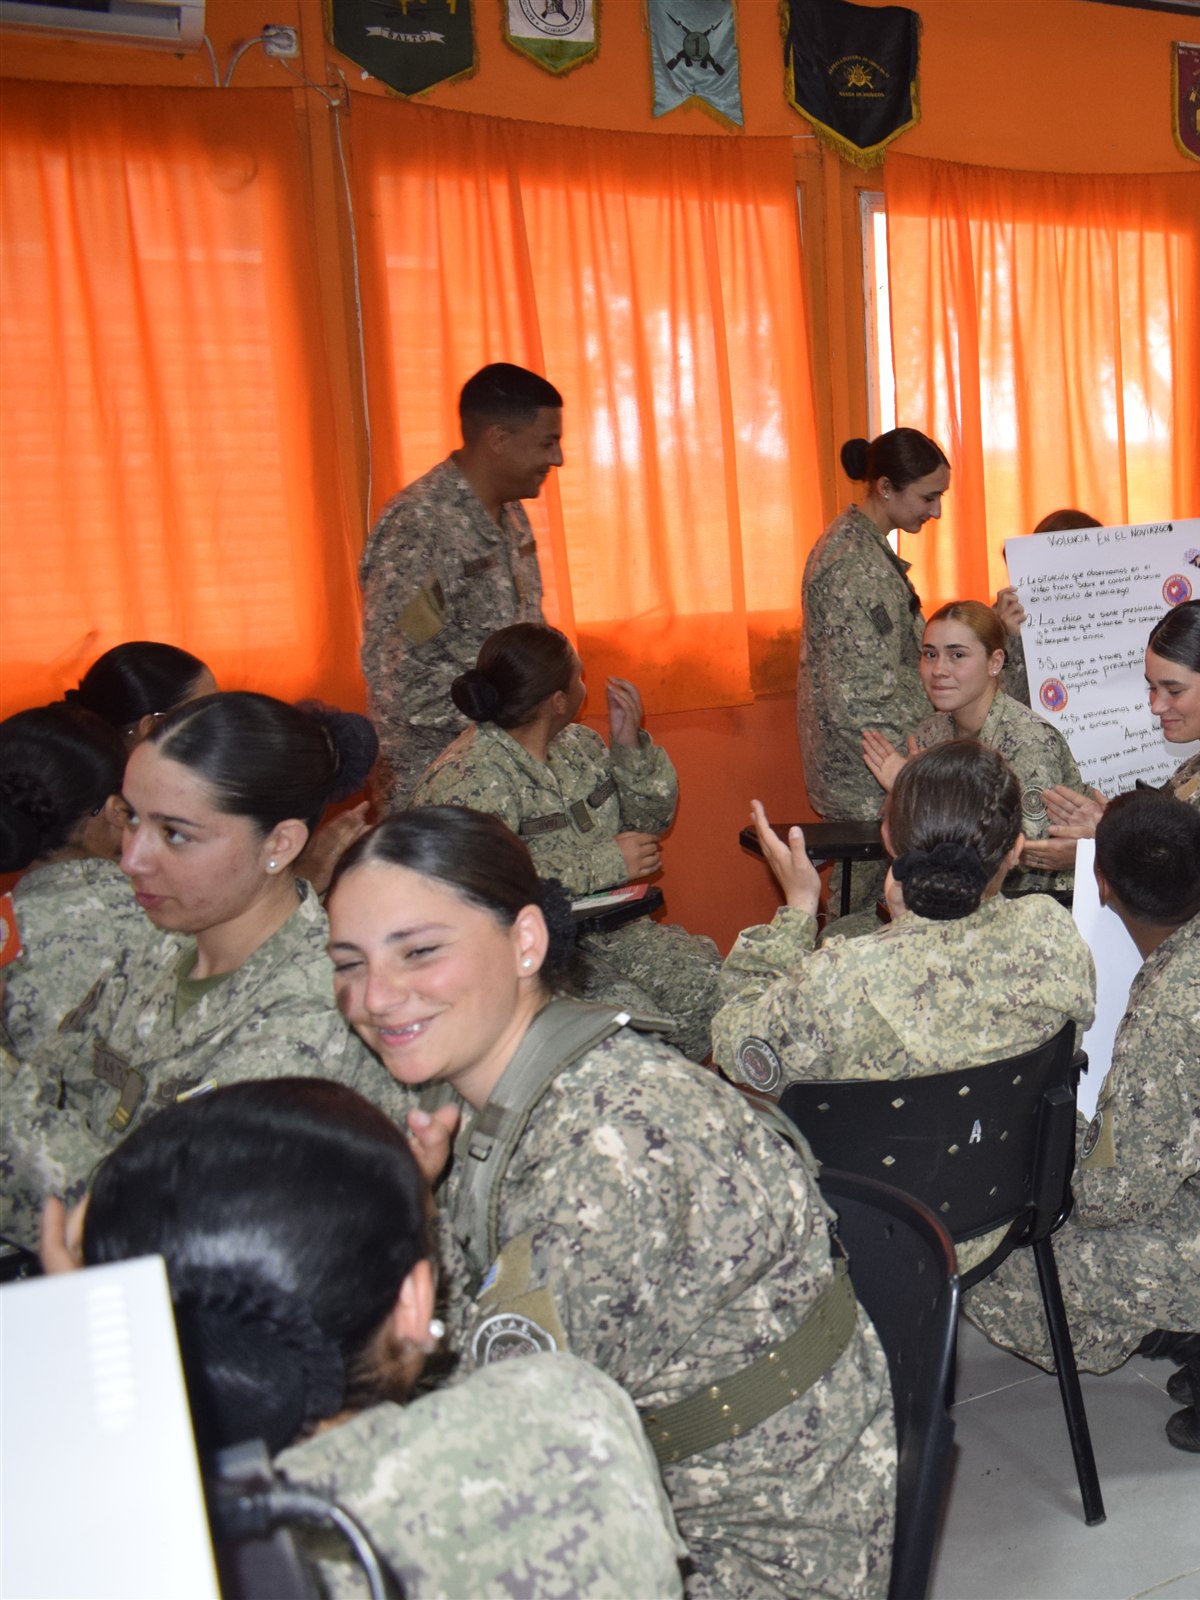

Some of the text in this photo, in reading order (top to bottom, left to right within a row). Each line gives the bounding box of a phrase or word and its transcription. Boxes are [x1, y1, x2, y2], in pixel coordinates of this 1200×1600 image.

[387, 31, 427, 42] SALTO
[1061, 613, 1083, 623] chica
[1059, 658, 1085, 671] amiga
[968, 1119, 983, 1145] A
